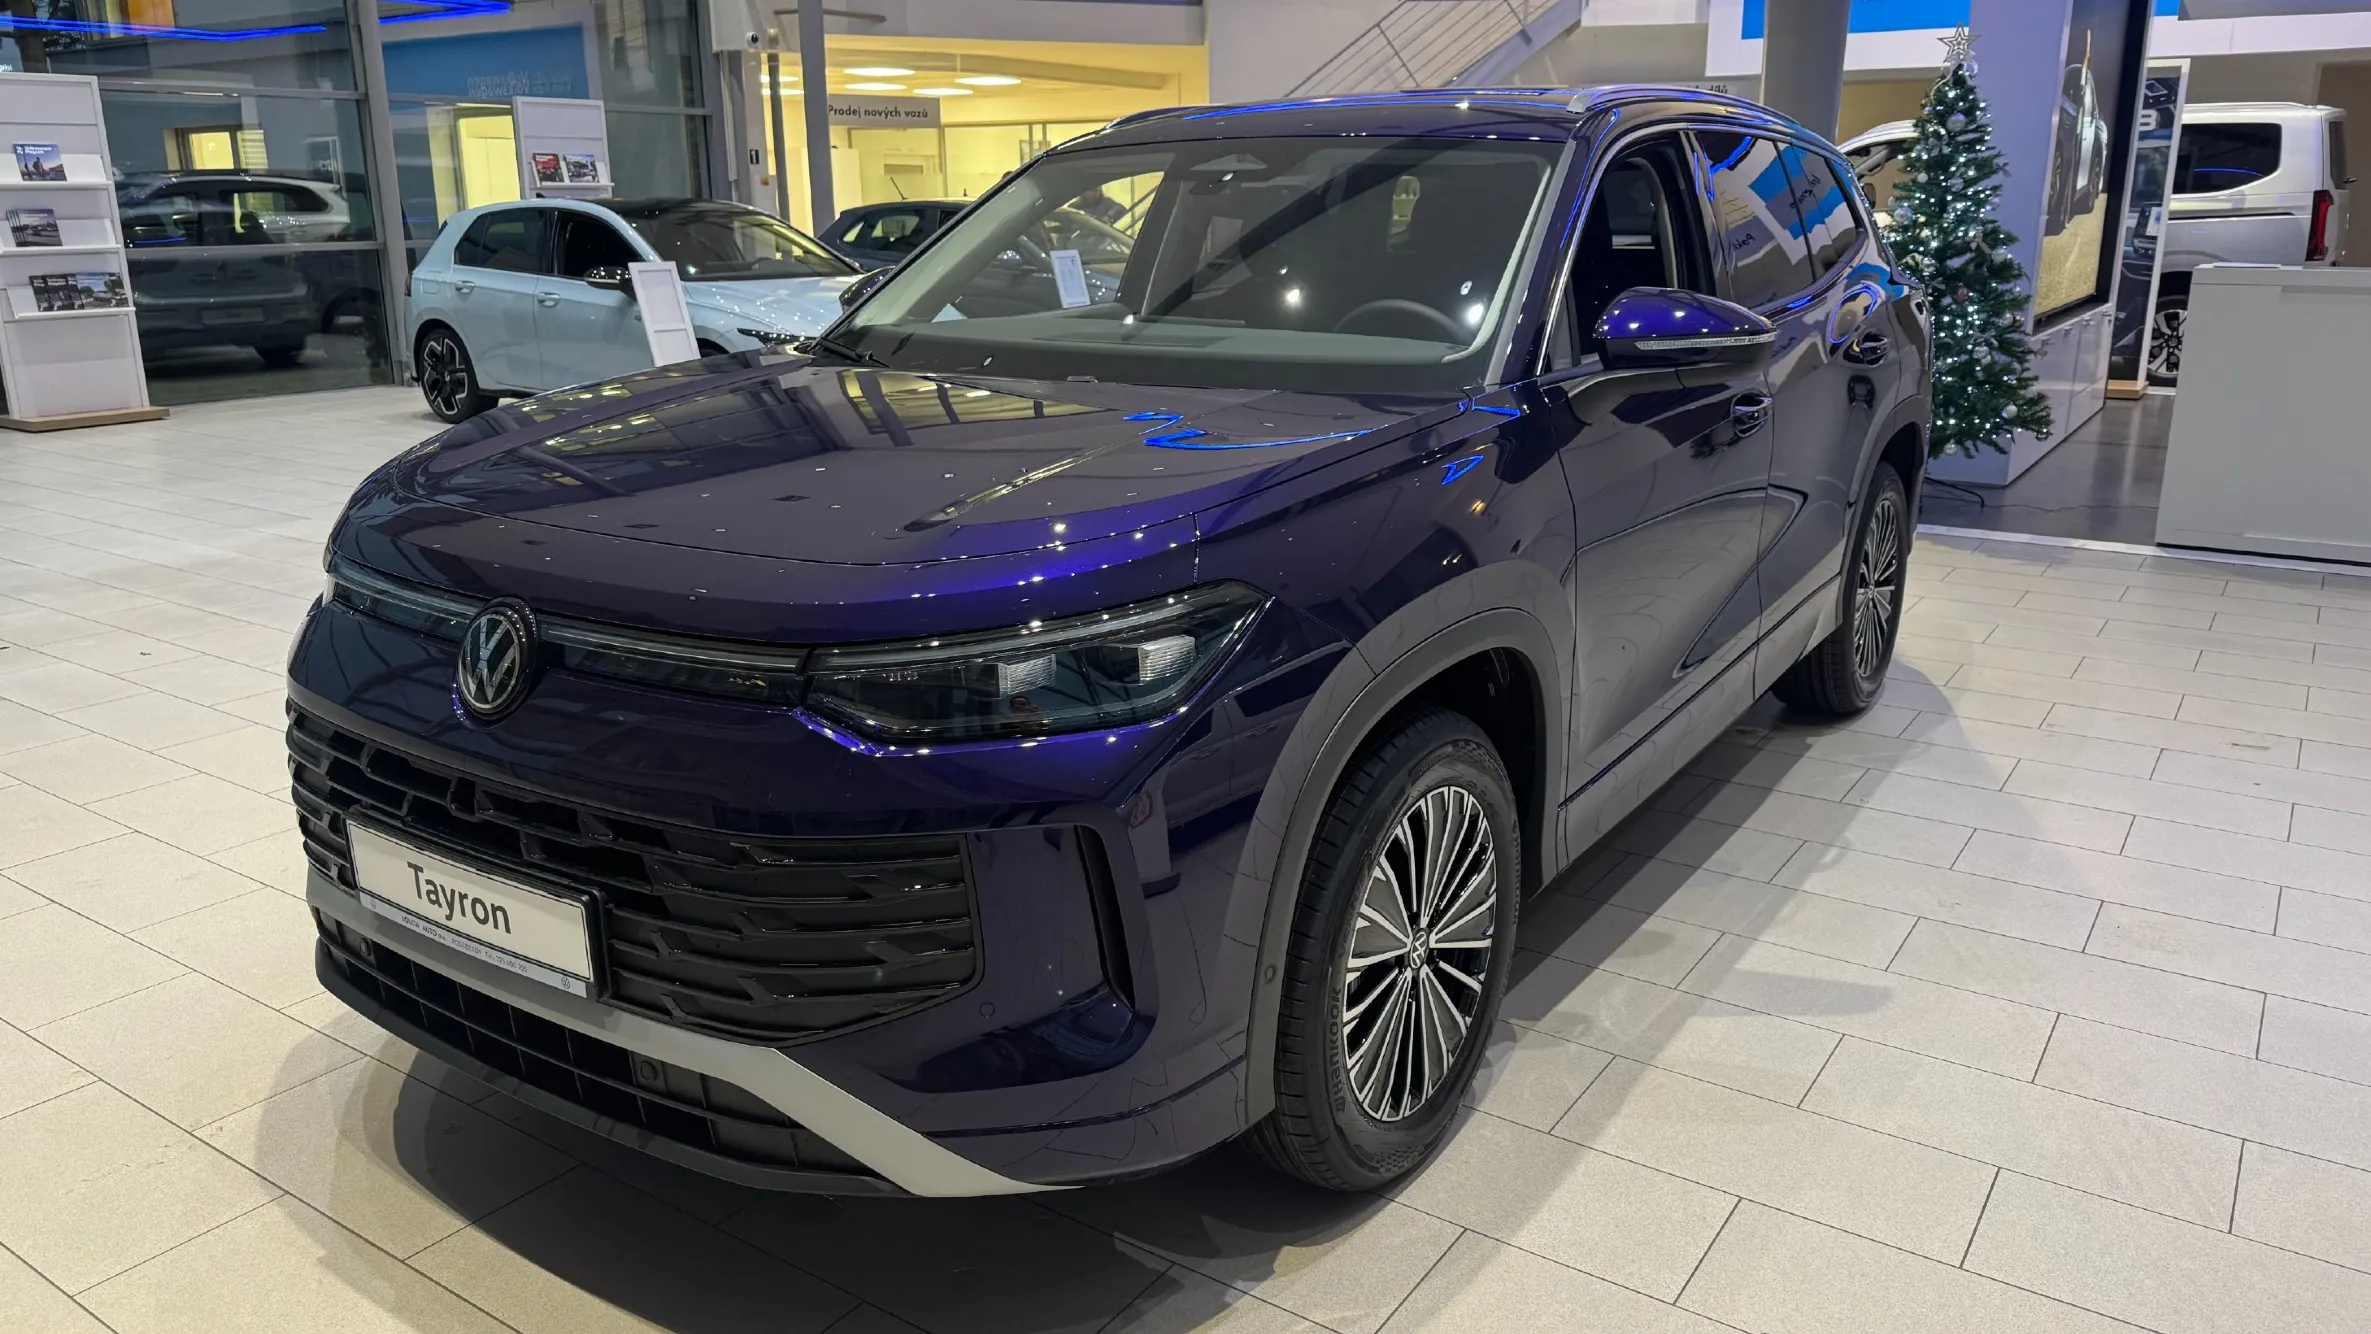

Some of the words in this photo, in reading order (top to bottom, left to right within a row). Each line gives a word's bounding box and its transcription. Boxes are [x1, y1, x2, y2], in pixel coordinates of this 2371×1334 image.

[828, 104, 861, 119] Prodej
[864, 106, 901, 119] nových
[904, 108, 928, 119] vozů
[407, 861, 512, 935] Tayron
